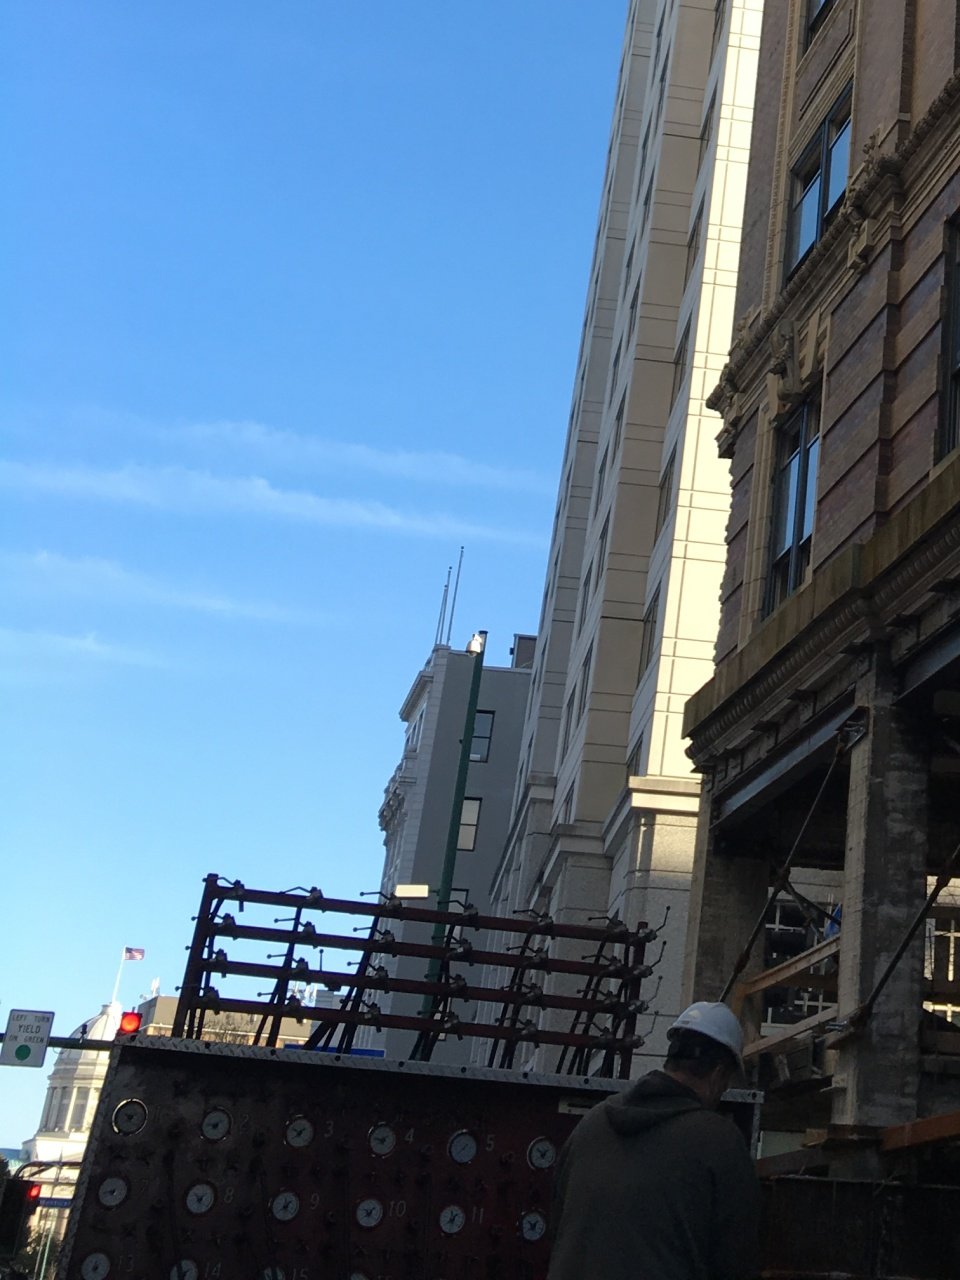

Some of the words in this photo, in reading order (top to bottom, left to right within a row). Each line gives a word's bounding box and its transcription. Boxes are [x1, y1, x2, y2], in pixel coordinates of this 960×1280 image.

[18, 1024, 41, 1034] YIELD
[24, 1035, 45, 1044] GREEN
[240, 1113, 250, 1131] 2
[323, 1120, 334, 1138] 3
[403, 1127, 416, 1144] 4
[485, 1134, 496, 1152] 5
[223, 1186, 235, 1204] 8
[310, 1192, 321, 1210] 9
[388, 1200, 407, 1218] 10
[471, 1206, 485, 1224] 11
[204, 1262, 222, 1278] 14
